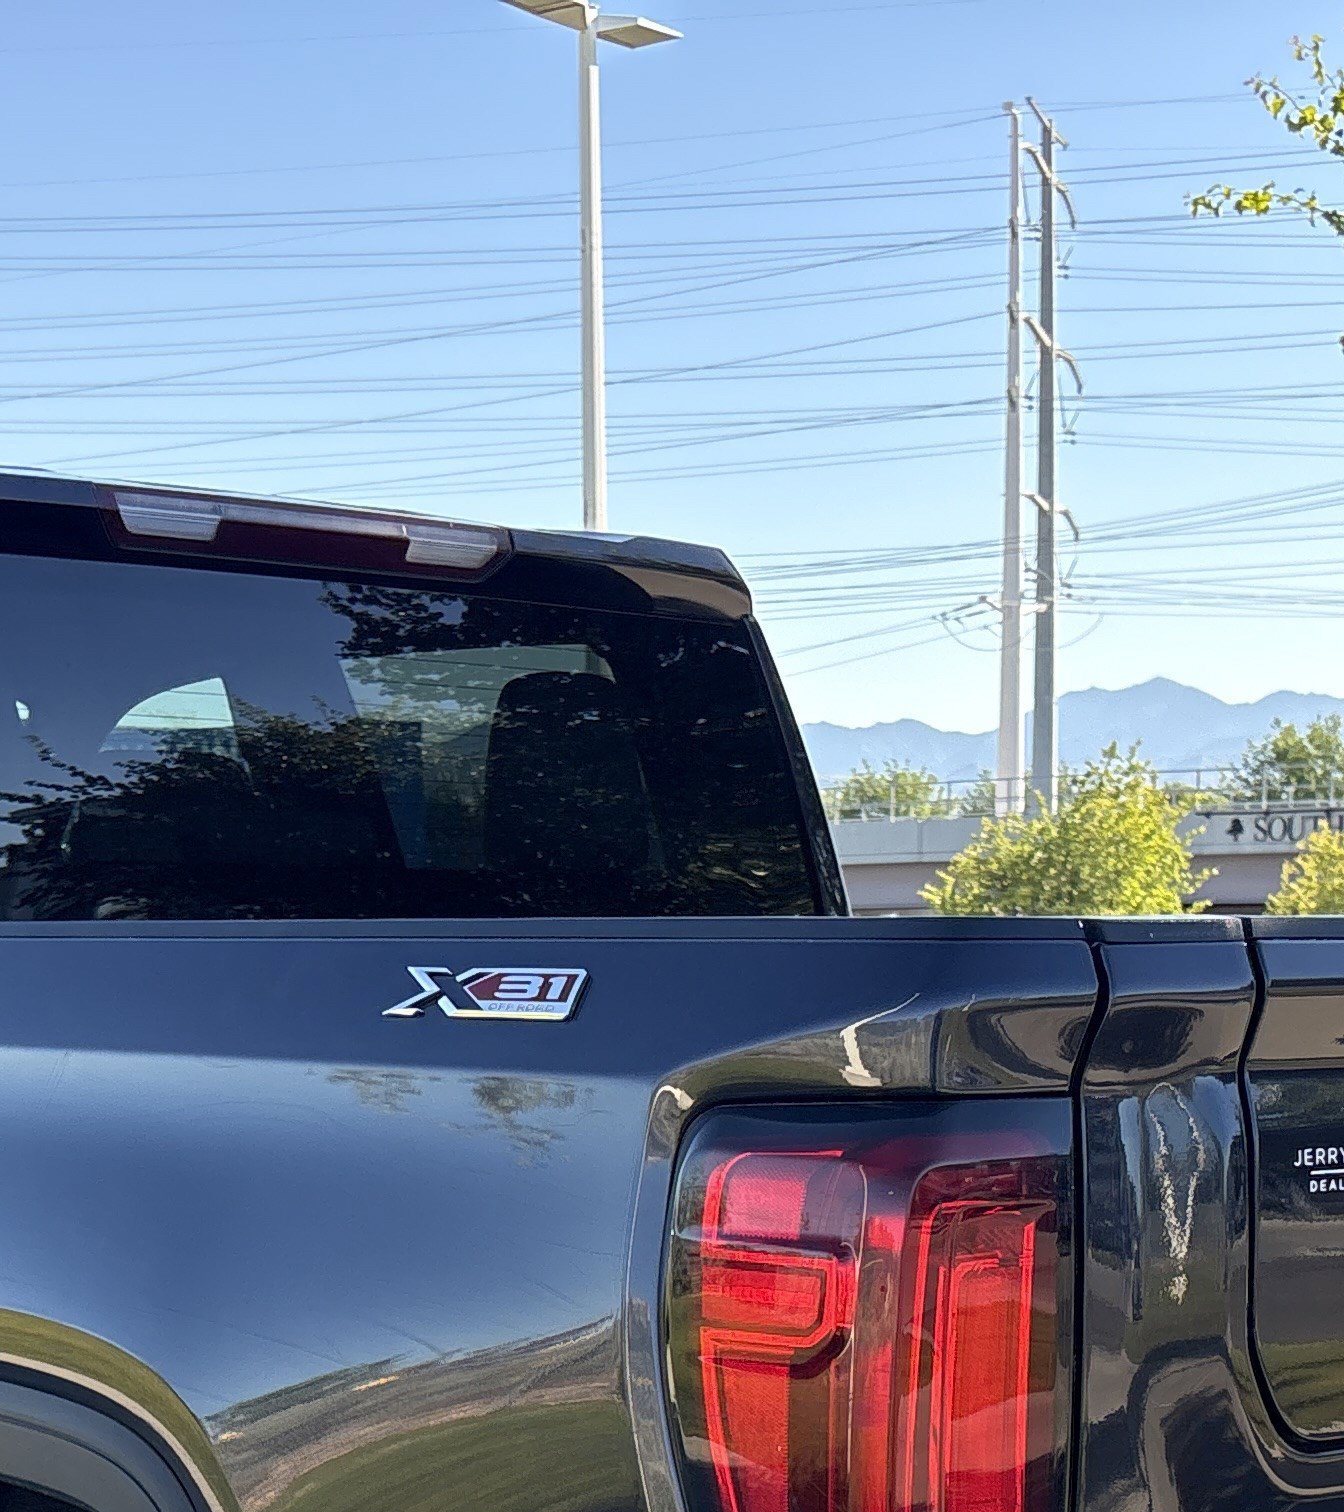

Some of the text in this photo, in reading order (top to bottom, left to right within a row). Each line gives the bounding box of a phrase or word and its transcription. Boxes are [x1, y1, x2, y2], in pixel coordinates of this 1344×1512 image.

[381, 966, 587, 1019] X31
[488, 1003, 555, 1013] OFF ROAD
